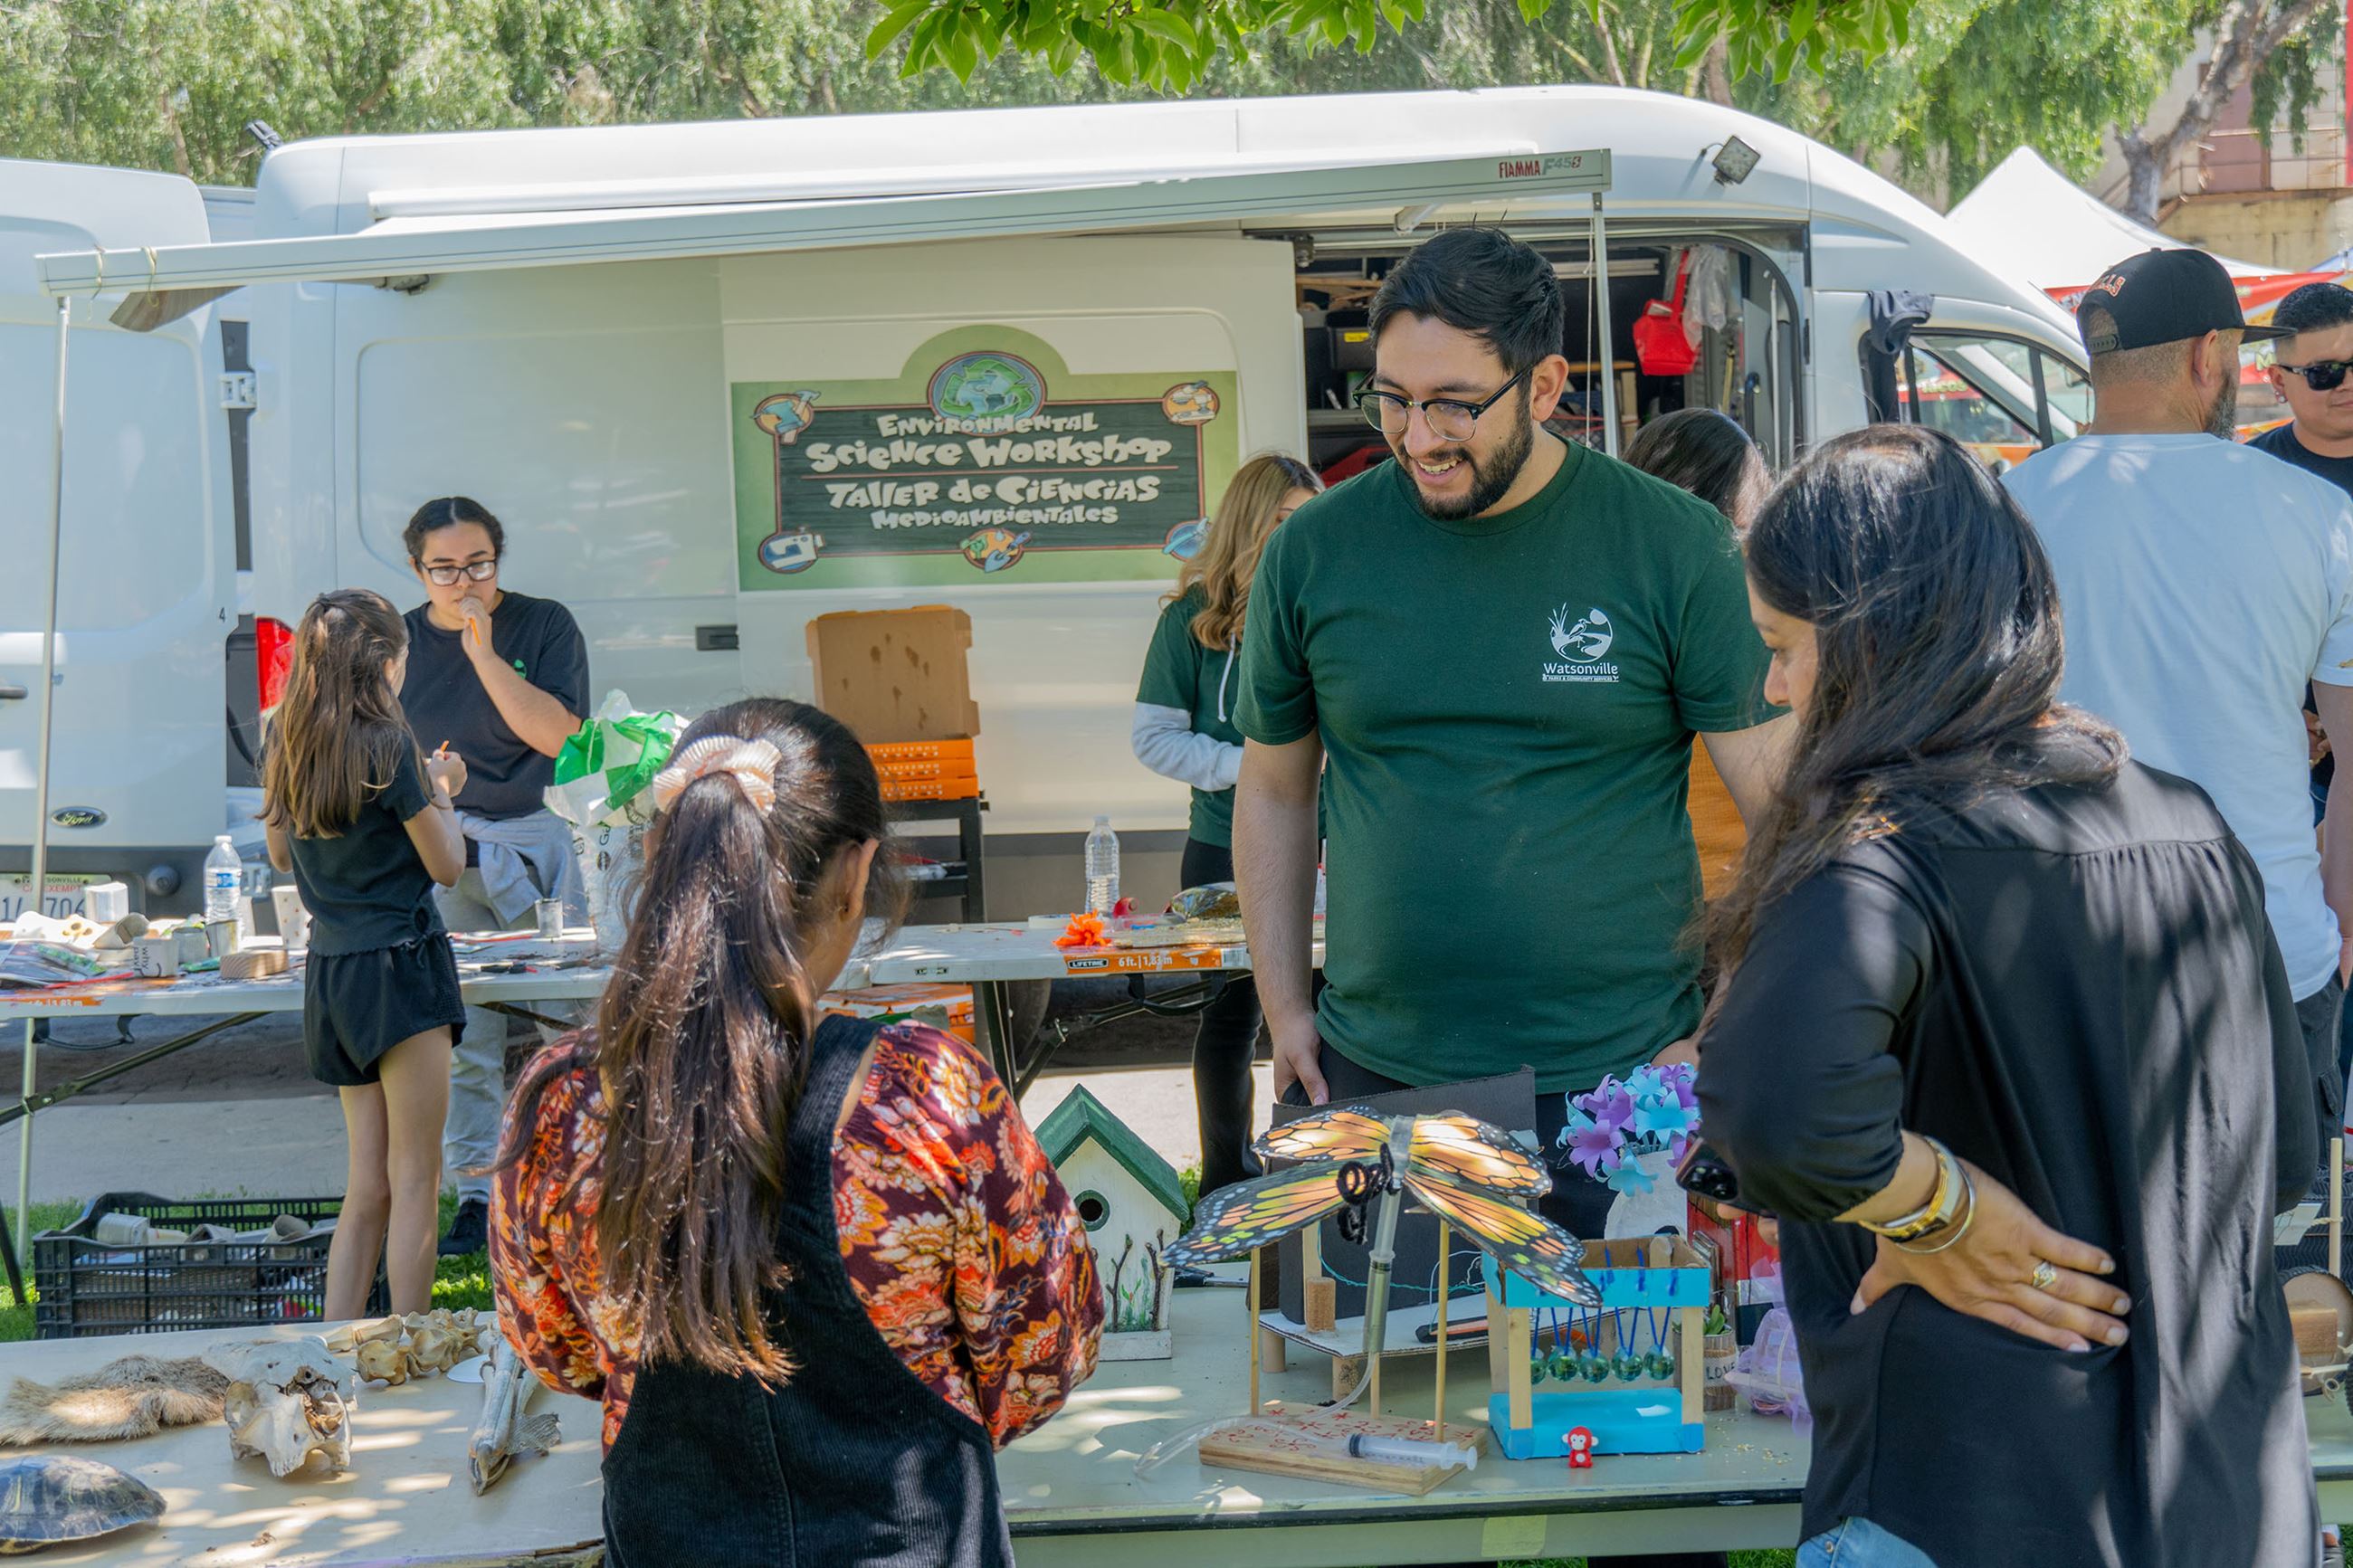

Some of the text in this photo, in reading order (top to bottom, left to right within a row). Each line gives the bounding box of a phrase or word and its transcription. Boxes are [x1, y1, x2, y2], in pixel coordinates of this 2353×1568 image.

[1499, 160, 1541, 179] FIAMMA
[948, 479, 993, 504] de
[1543, 661, 1619, 675] Watsonville
[62, 812, 94, 825] Ford
[1118, 957, 1125, 967] 6
